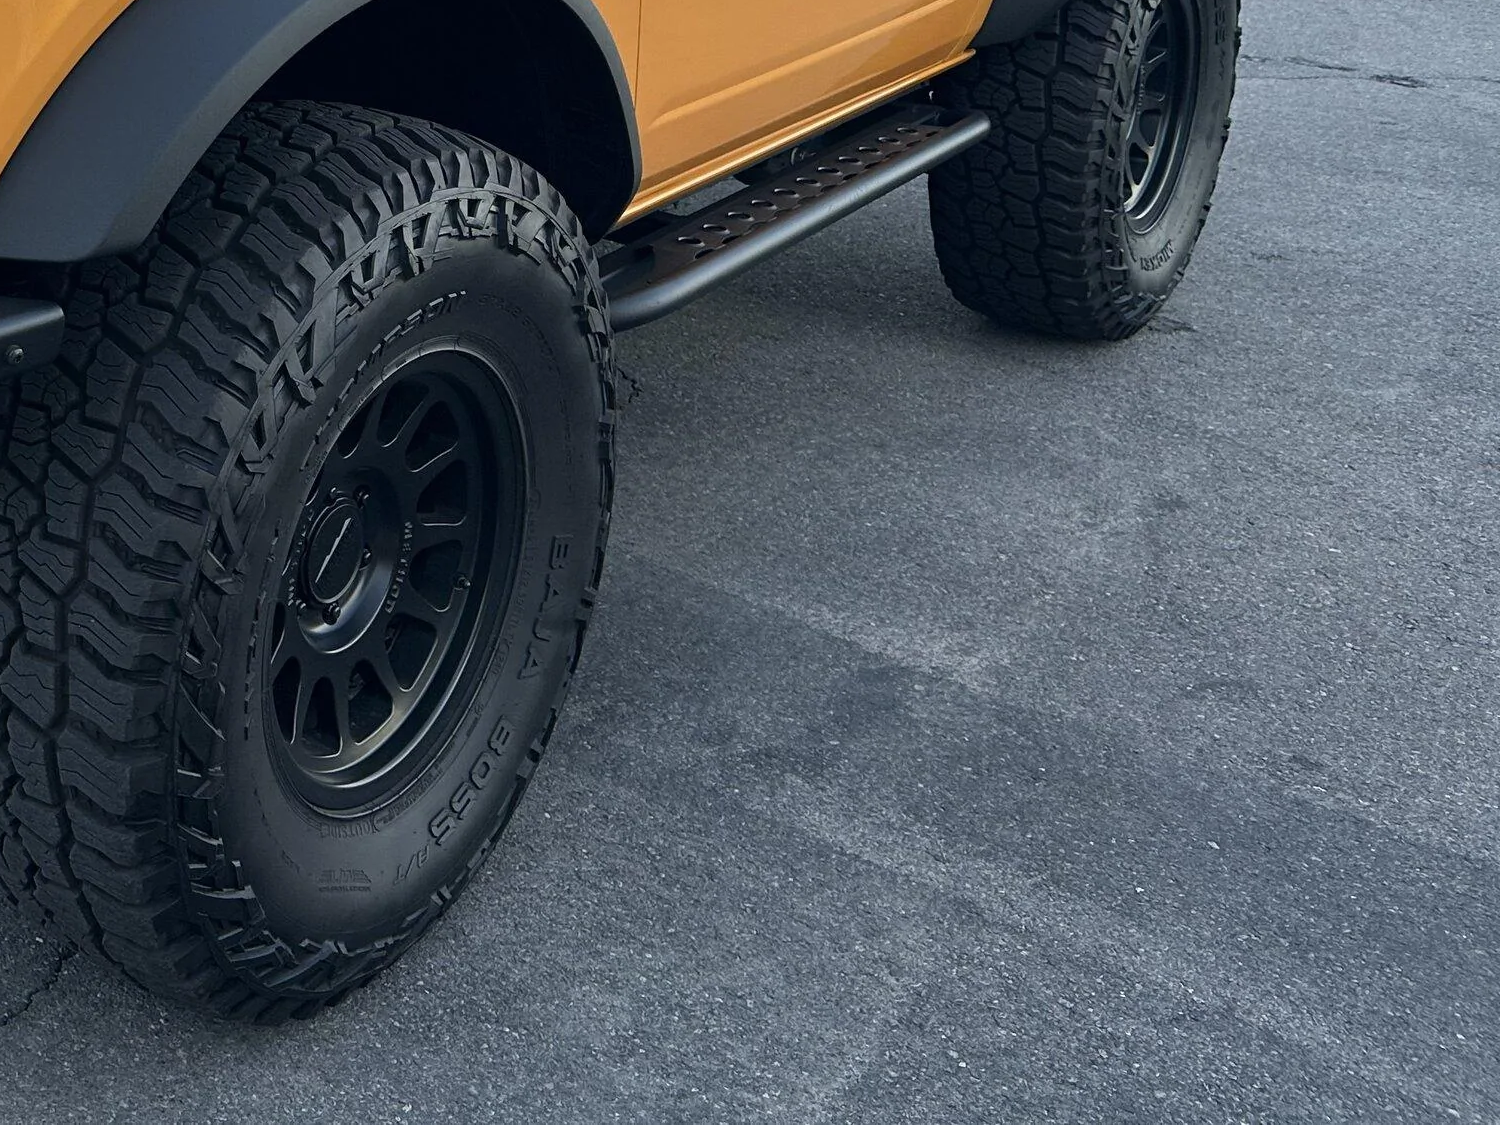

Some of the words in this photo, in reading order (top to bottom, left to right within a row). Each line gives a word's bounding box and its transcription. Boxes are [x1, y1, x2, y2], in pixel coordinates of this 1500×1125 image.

[516, 534, 575, 681] BAJA
[428, 714, 515, 847] BOSS
[392, 843, 431, 887] A/T
